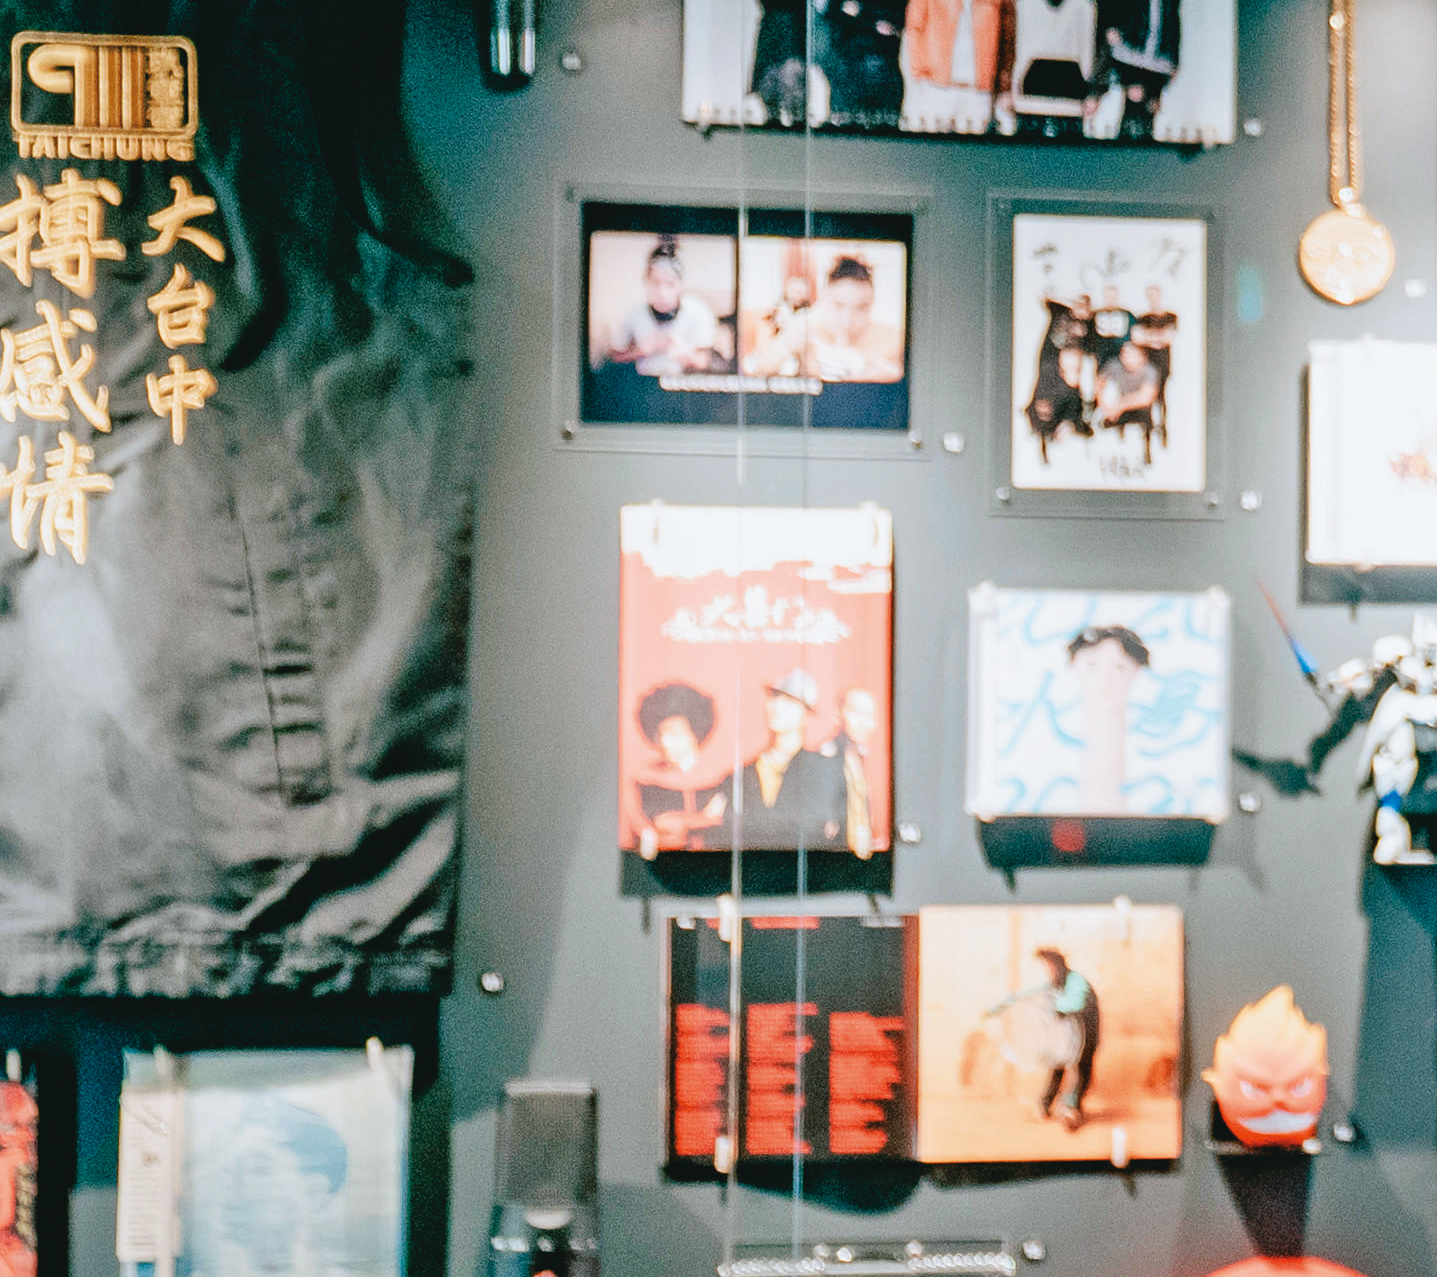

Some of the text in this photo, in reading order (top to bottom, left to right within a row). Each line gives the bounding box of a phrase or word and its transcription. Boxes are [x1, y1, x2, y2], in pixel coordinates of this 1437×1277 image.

[13, 131, 196, 163] TAICHUNG
[141, 175, 226, 447] 大台中
